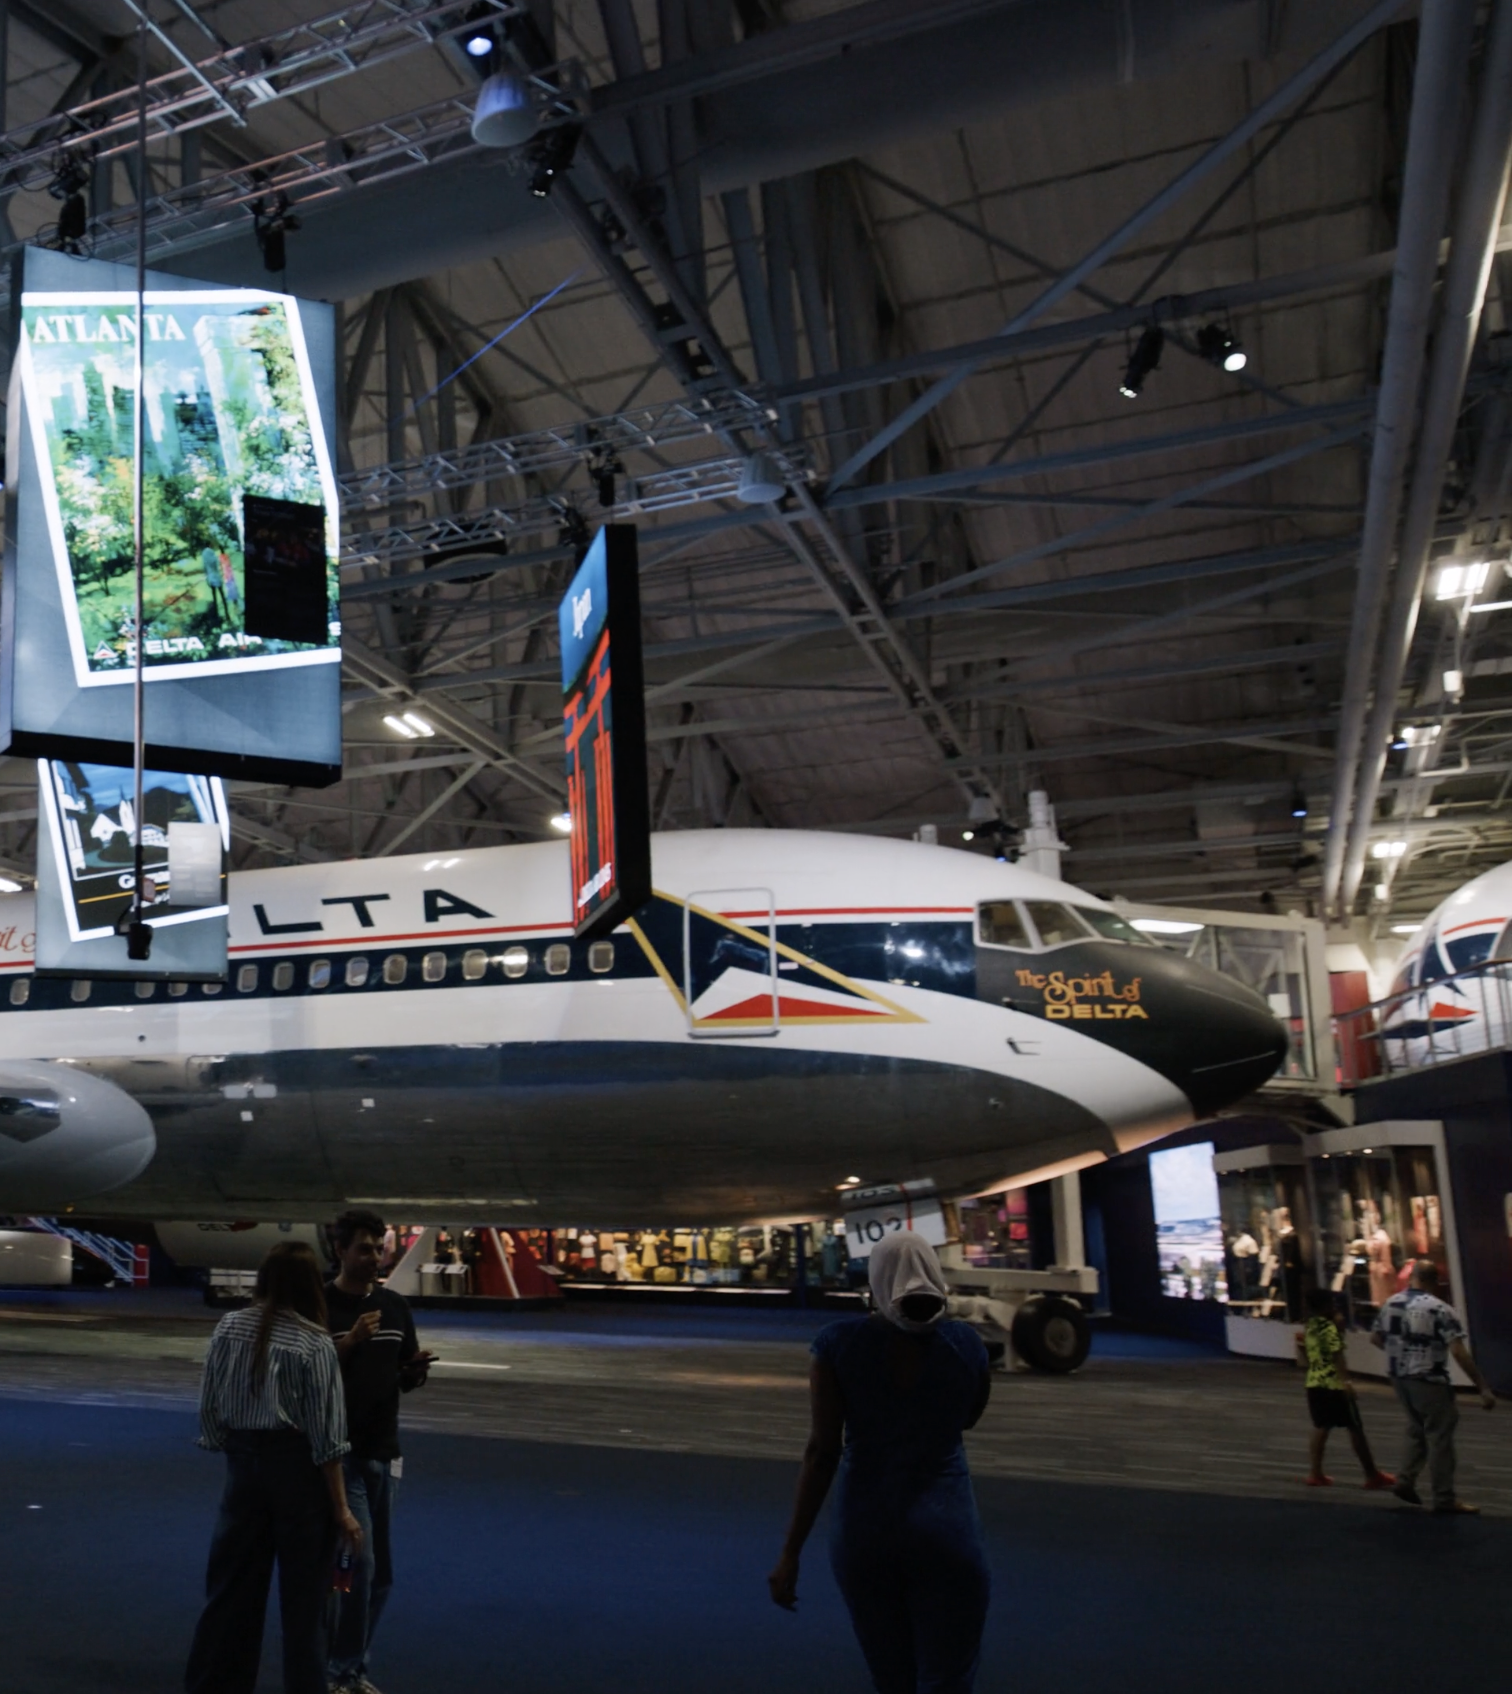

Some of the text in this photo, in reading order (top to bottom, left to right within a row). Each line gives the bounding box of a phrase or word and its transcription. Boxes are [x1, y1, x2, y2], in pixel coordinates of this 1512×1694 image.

[32, 313, 187, 343] ATLANTA
[251, 888, 497, 935] LTA
[1014, 968, 1048, 989] The
[1043, 970, 1122, 1005] Spirit
[1044, 1004, 1150, 1020] DELTA
